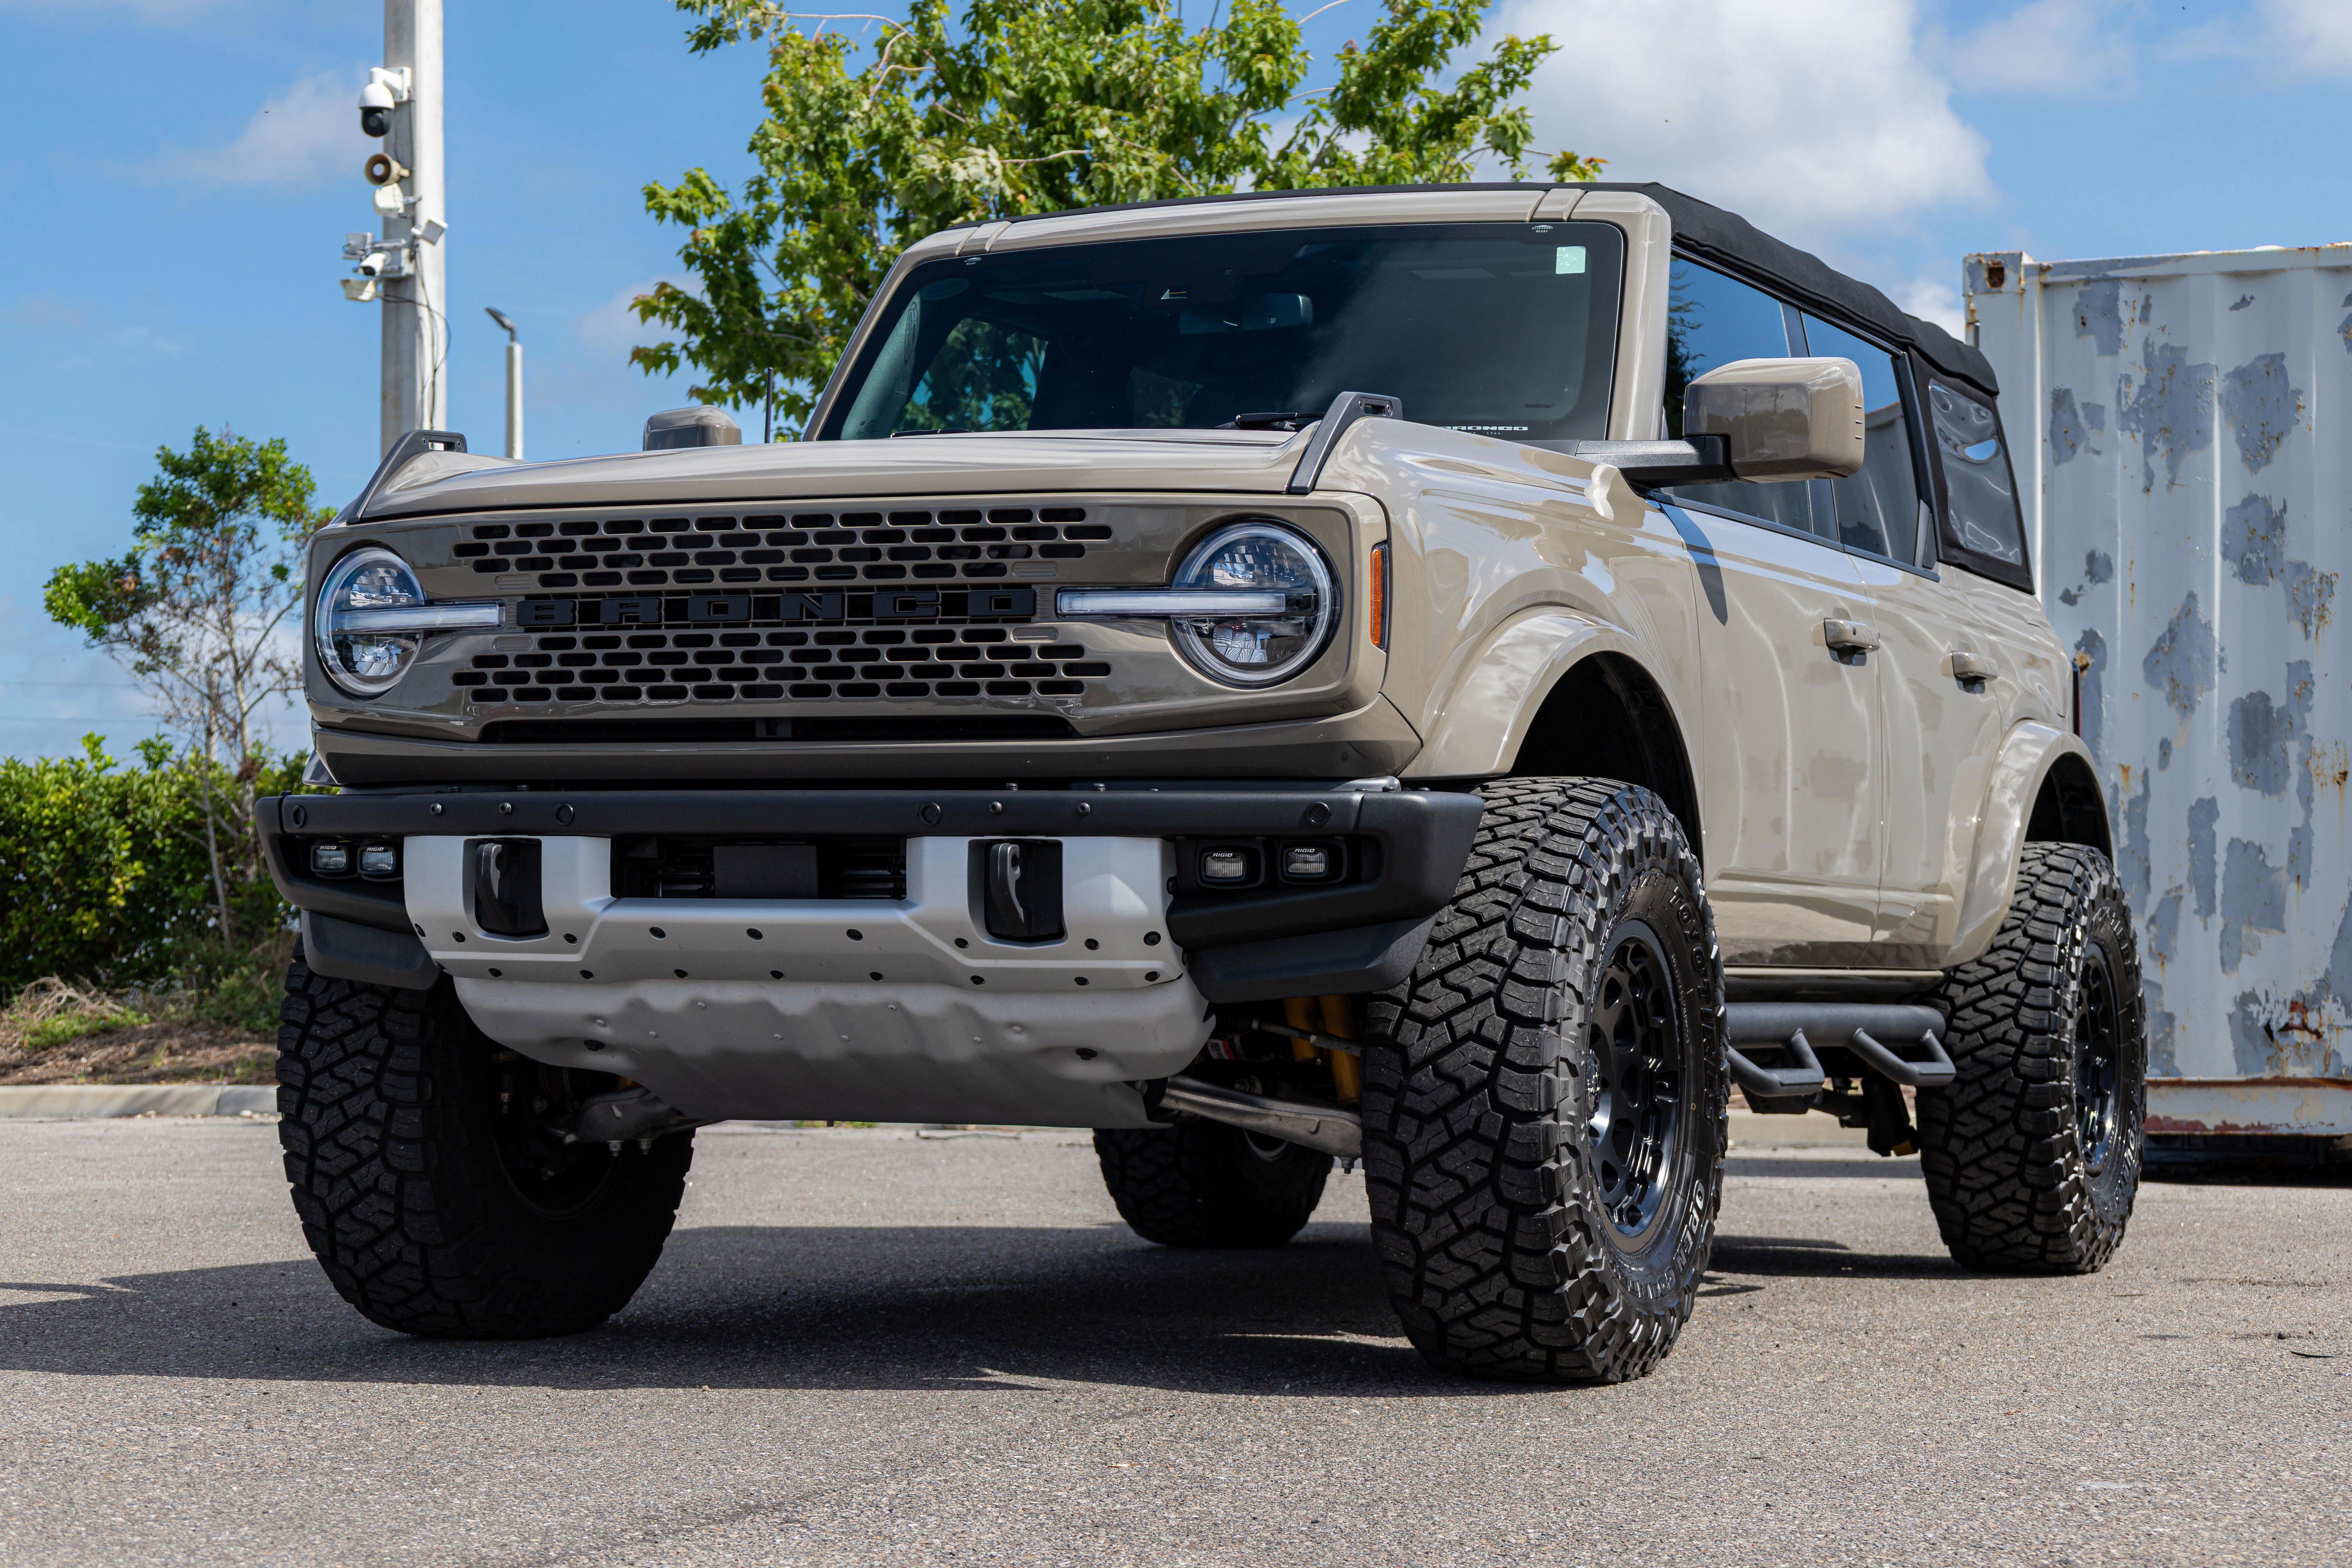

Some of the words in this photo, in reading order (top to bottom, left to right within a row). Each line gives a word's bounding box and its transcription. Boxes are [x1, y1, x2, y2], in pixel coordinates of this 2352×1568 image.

[516, 589, 1036, 627] BRONCO
[1669, 886, 1706, 973] TOYO
[1697, 978, 1717, 1126] TIRES
[1673, 1179, 1705, 1275] OPEN
